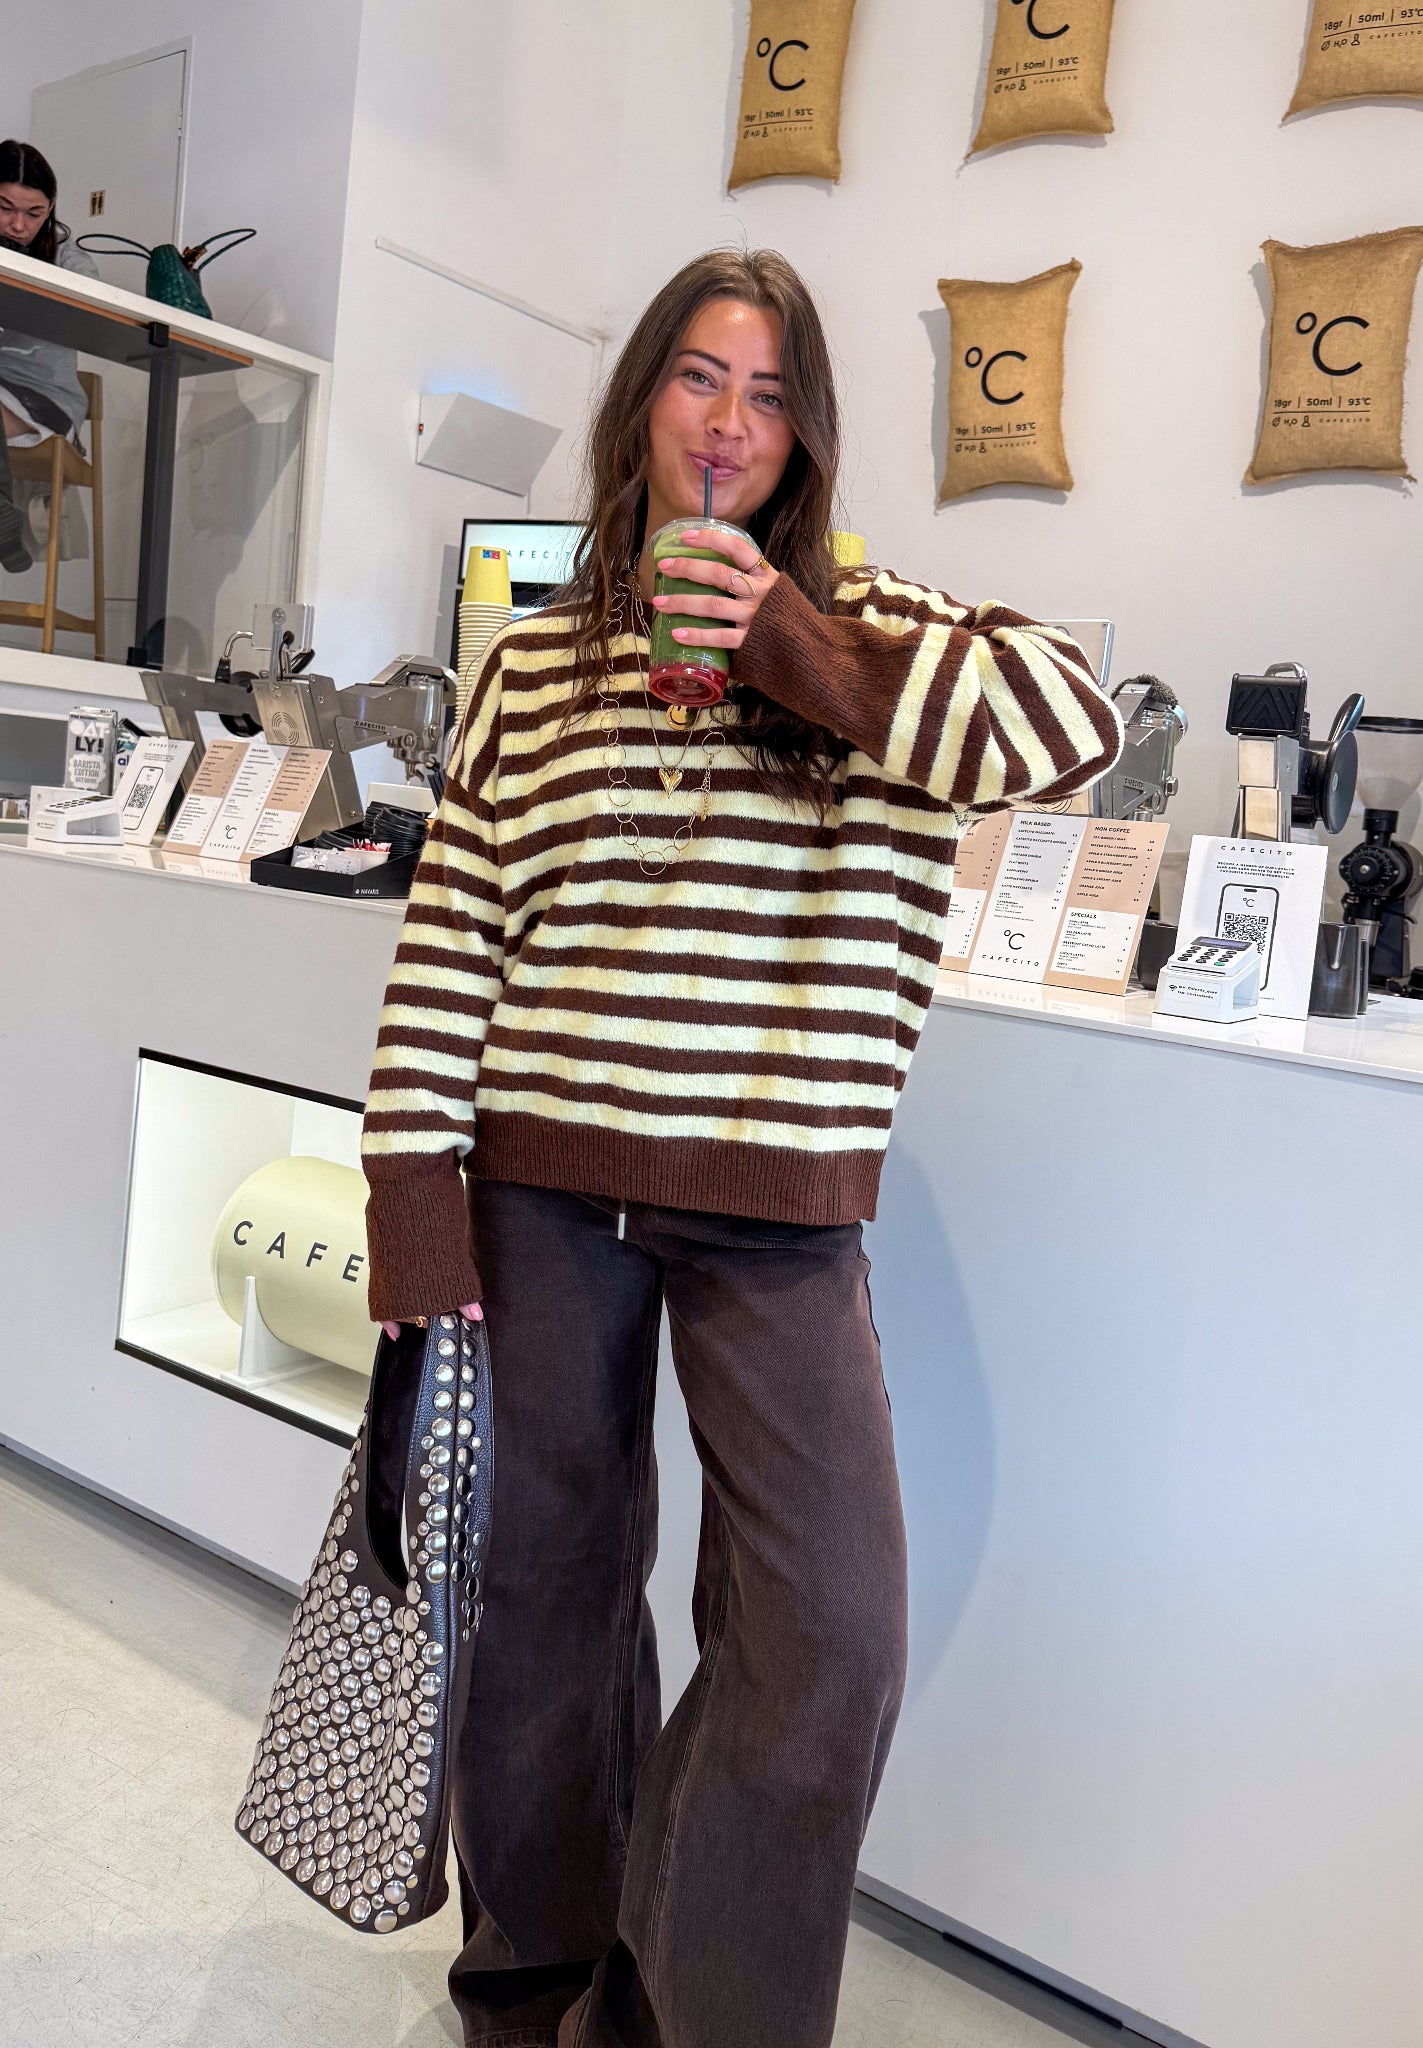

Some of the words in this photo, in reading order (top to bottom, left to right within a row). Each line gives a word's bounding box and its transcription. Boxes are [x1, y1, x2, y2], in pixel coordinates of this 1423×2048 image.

[1324, 21, 1343, 31] 18gr
[1358, 12, 1385, 23] 50ml
[1369, 30, 1422, 39] CAFECITO
[1023, 60, 1045, 70] 50ml
[765, 110, 784, 118] 50ml
[1274, 399, 1292, 408] 18gr
[1306, 397, 1333, 406] 50ml
[1348, 397, 1371, 406] 93°C
[981, 425, 1003, 434] 50ml
[355, 720, 386, 731] CAFECITO
[75, 736, 104, 753] LY!
[1221, 845, 1293, 856] CAFECITO
[1071, 911, 1097, 919] SPECIALS
[1003, 929, 1026, 950] °C
[982, 954, 1040, 967] CAFECITO
